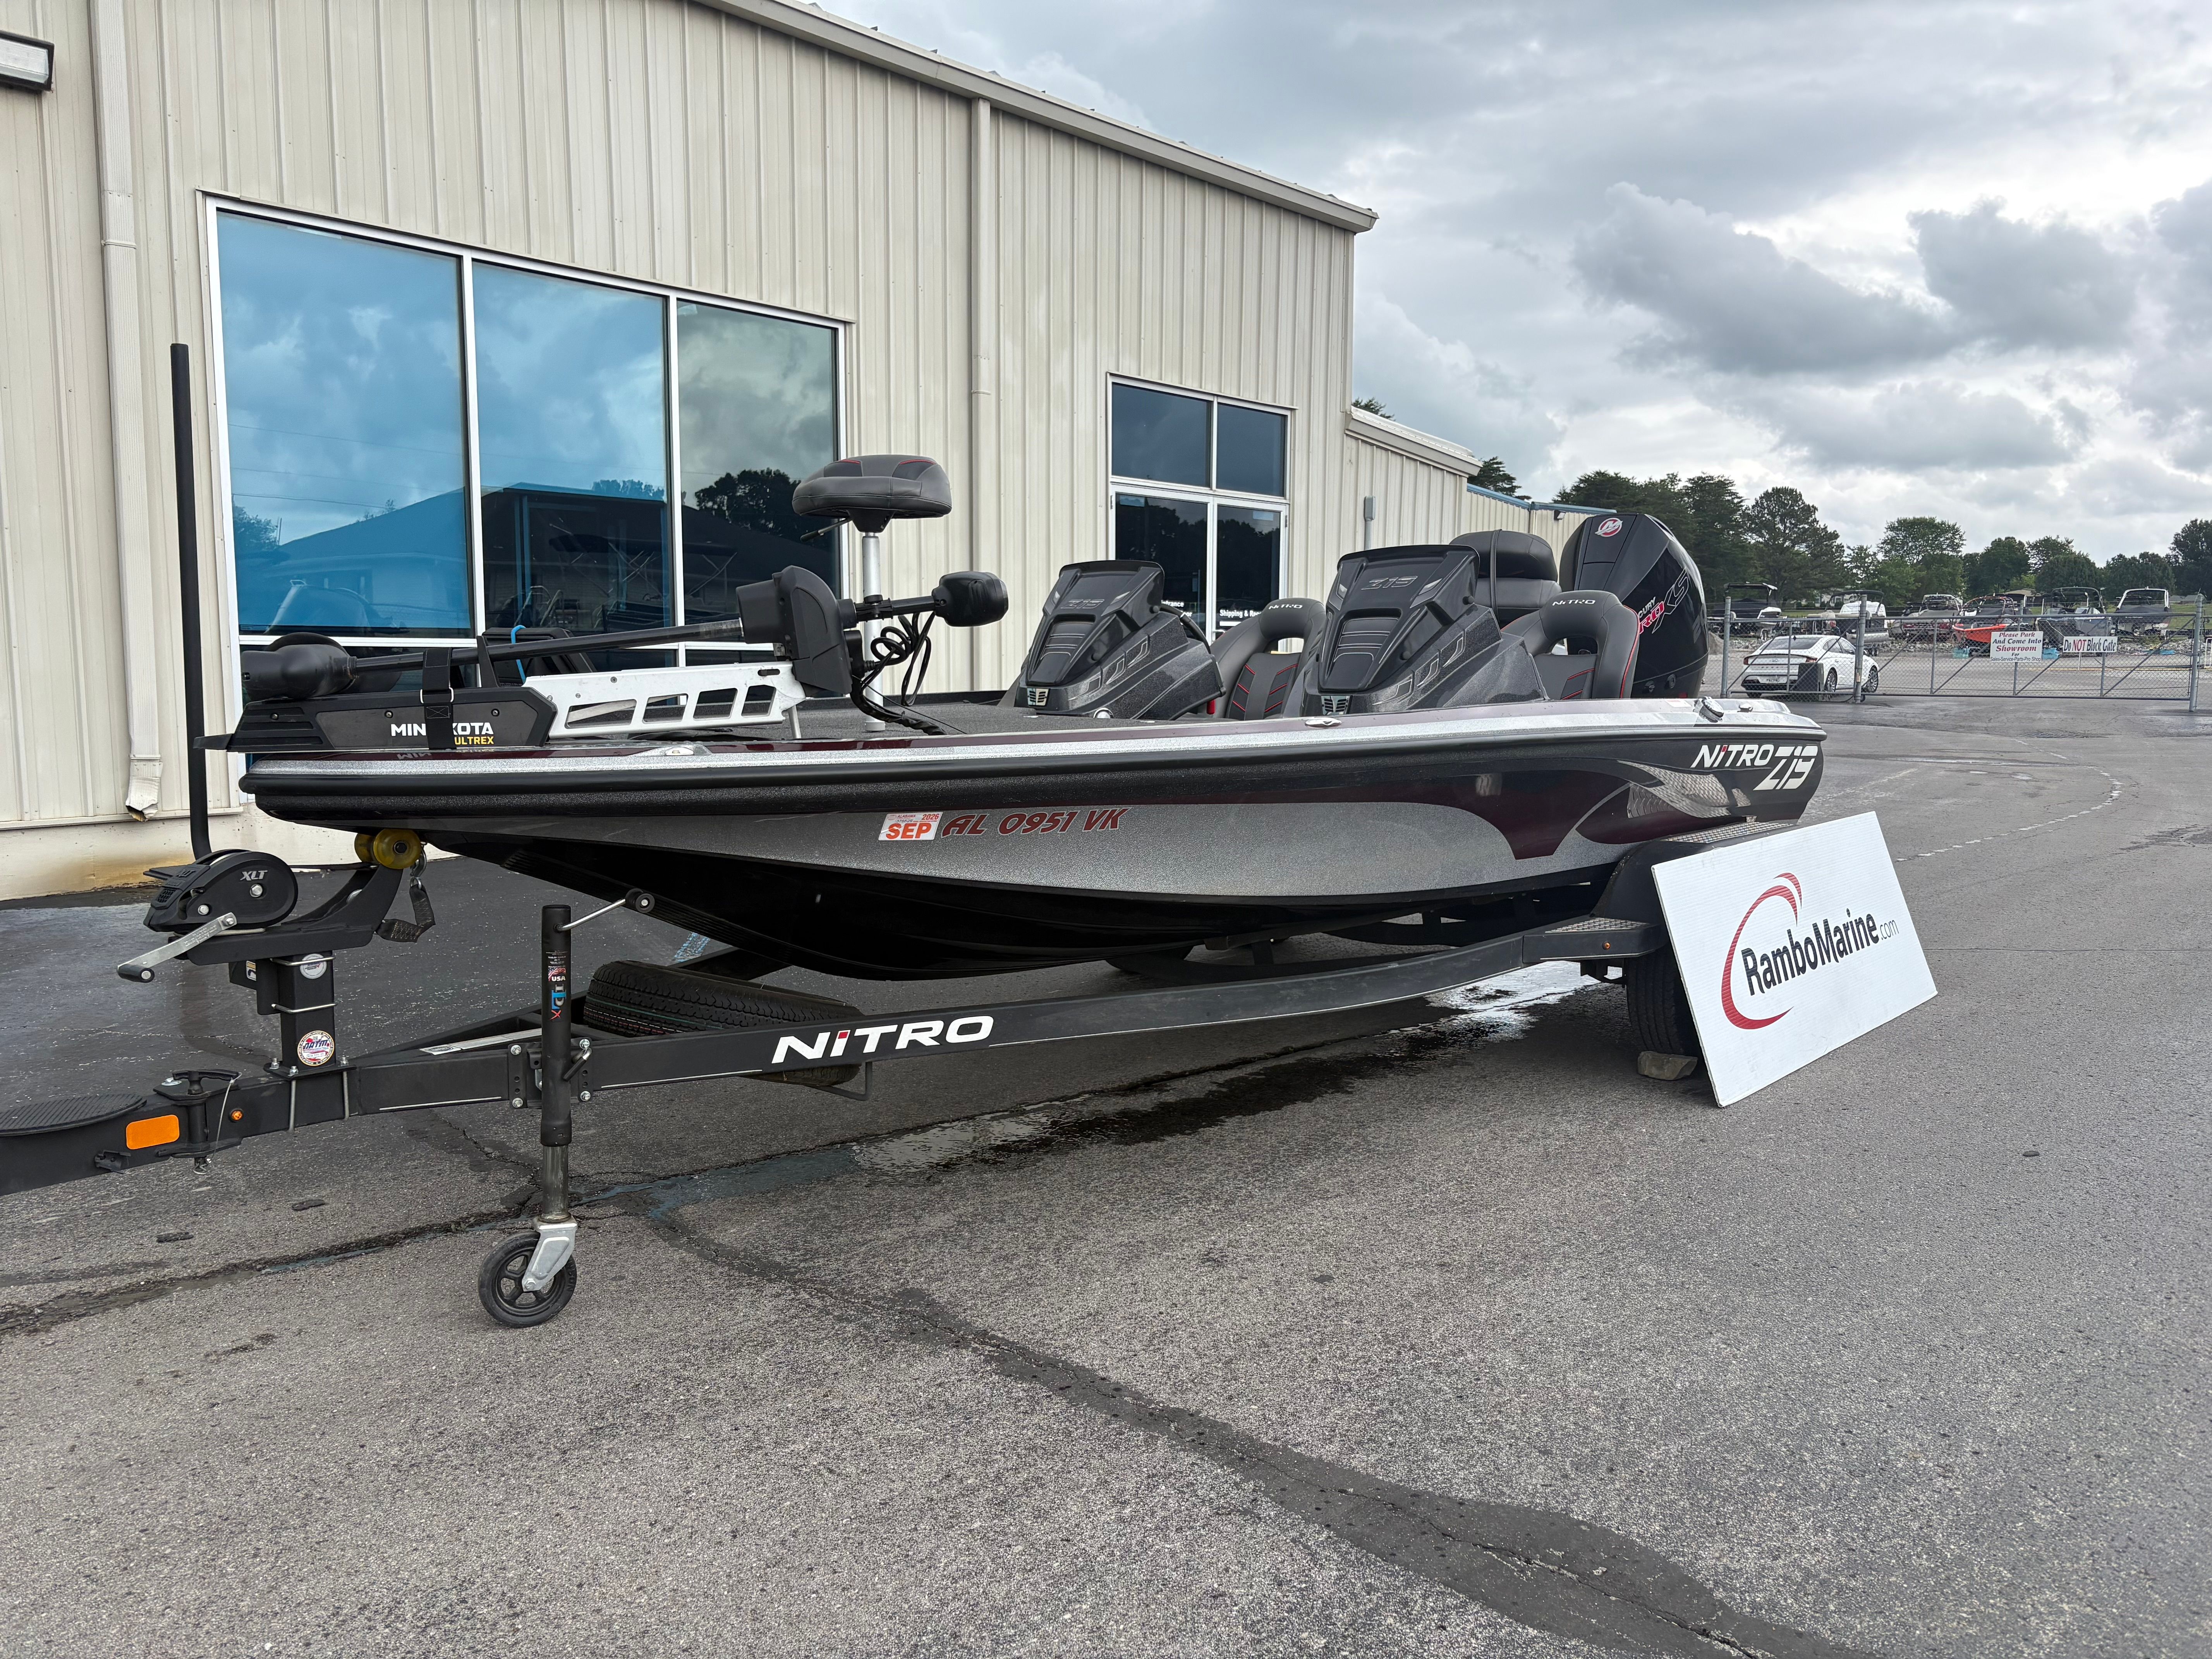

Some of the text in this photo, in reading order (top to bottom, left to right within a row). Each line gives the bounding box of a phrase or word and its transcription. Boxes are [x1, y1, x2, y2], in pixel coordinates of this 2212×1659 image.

[1361, 575, 1418, 590] Z19
[1060, 599, 1105, 609] Z19
[1219, 609, 1243, 618] Shipping
[2064, 638, 2116, 651] Do NOT Block Gate
[454, 736, 494, 745] ULTREX
[1753, 745, 1818, 791] Z19
[941, 807, 1132, 839] AL 0951 VK
[886, 823, 932, 840] SEP
[240, 870, 268, 881] XLT
